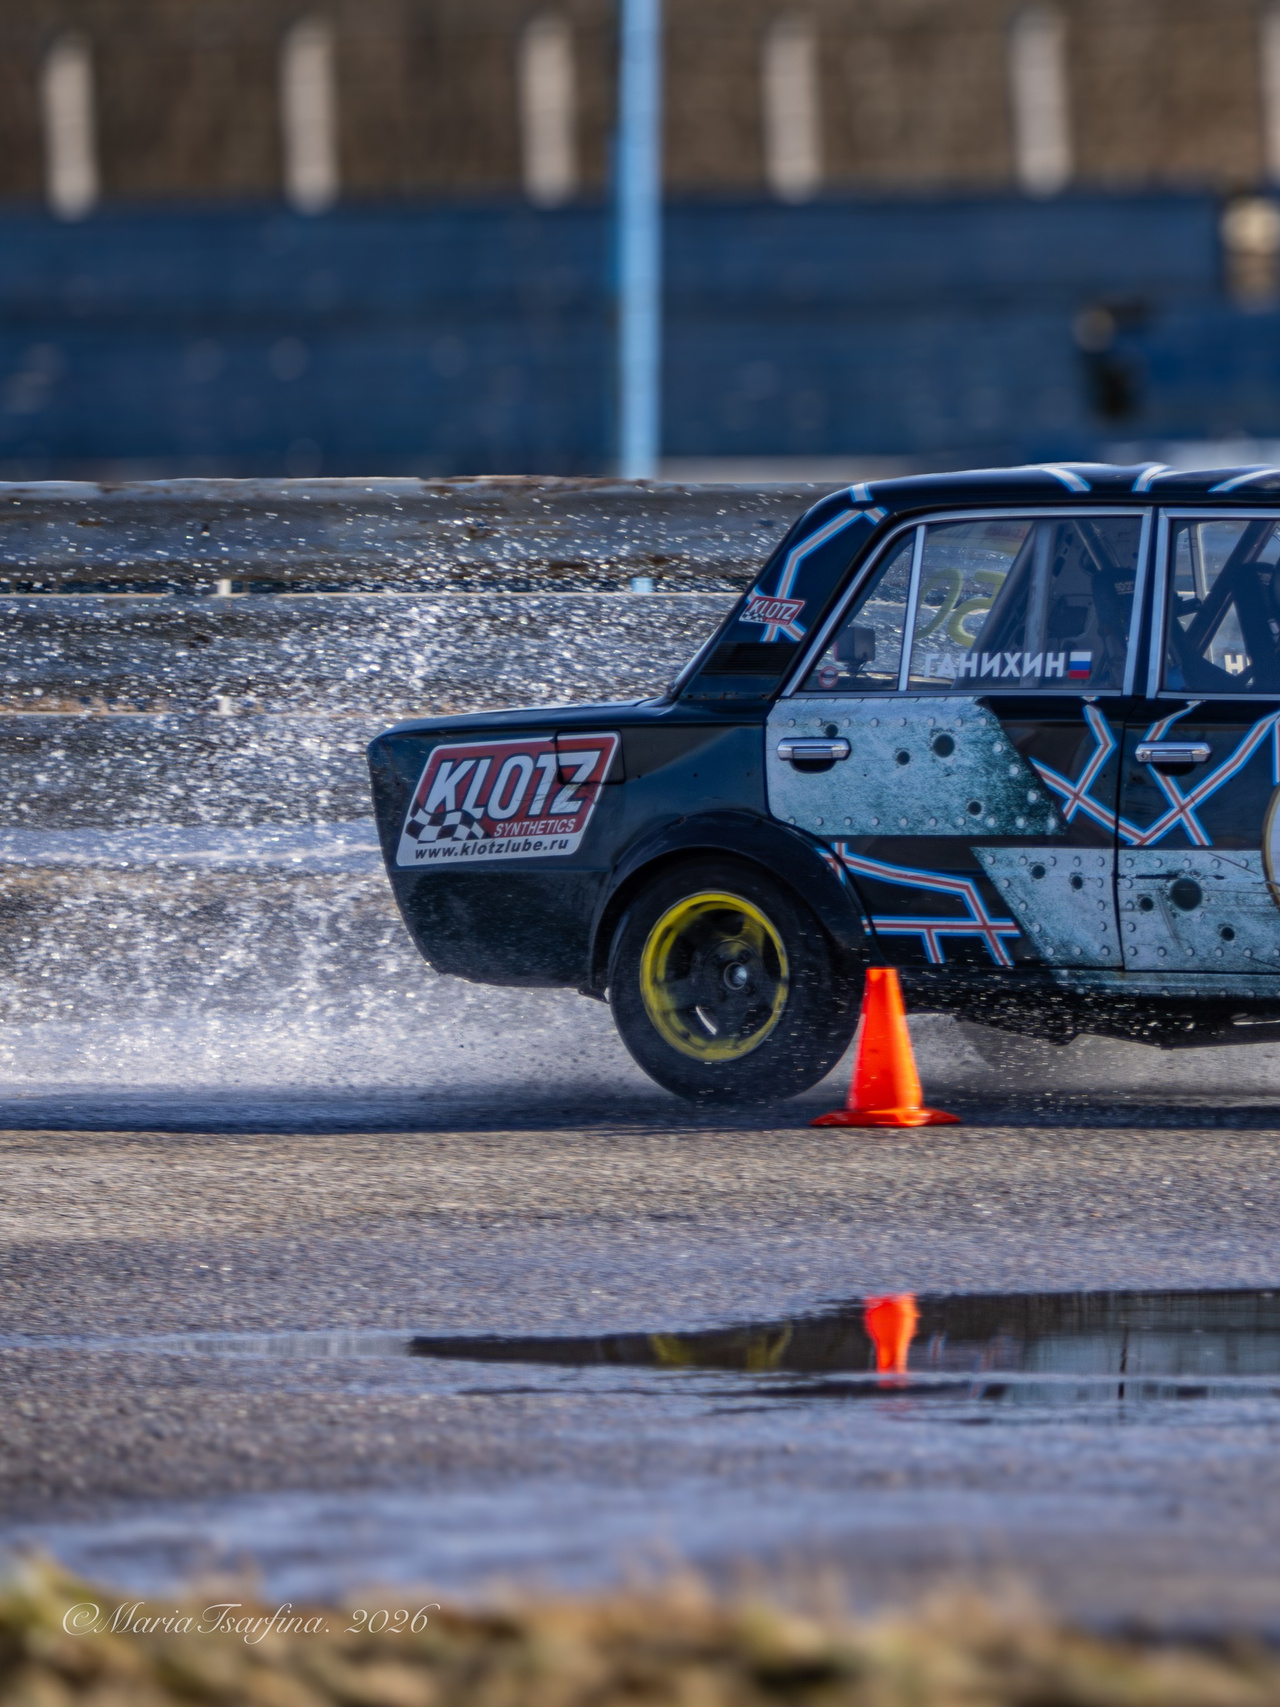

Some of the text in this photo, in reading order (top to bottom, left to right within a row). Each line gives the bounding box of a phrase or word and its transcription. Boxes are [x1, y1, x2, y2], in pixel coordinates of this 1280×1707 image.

[749, 600, 799, 620] KLOTZ
[924, 652, 1066, 678] ГАНИХИН
[424, 750, 602, 820] KLOTZ
[494, 818, 577, 837] SYNTHETICS
[415, 838, 569, 859] www.klotzlube.ru
